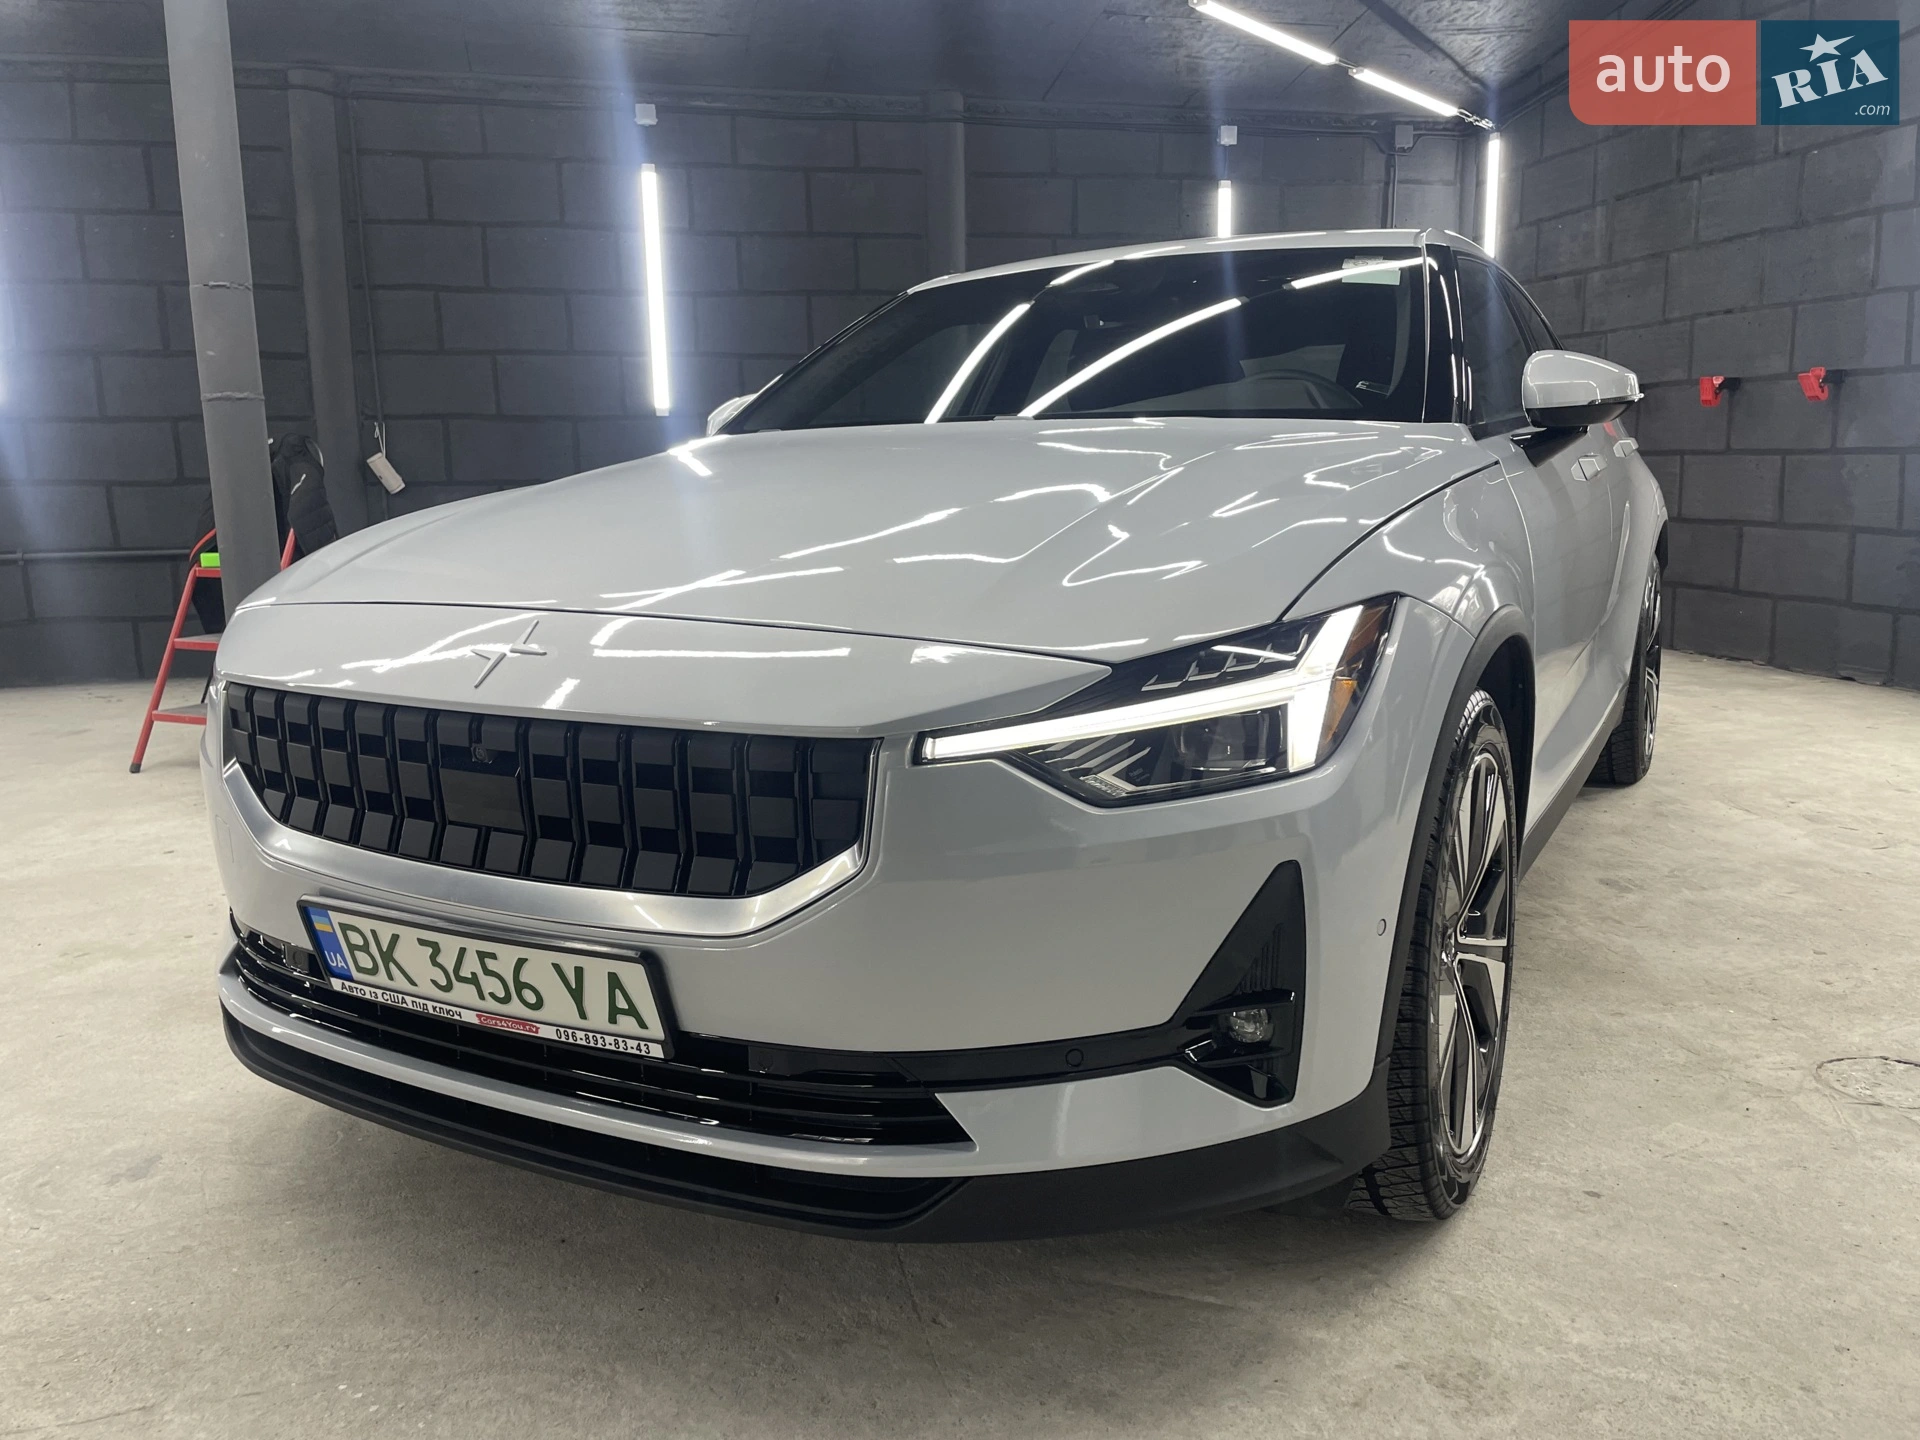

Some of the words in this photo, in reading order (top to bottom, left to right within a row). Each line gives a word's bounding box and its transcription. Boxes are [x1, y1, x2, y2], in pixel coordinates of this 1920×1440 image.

[324, 950, 348, 970] UA
[337, 921, 419, 987] BK
[416, 937, 544, 1011] 3456
[551, 962, 649, 1030] YA
[381, 991, 409, 1007] США
[555, 1028, 651, 1055] 096-893-83-43
